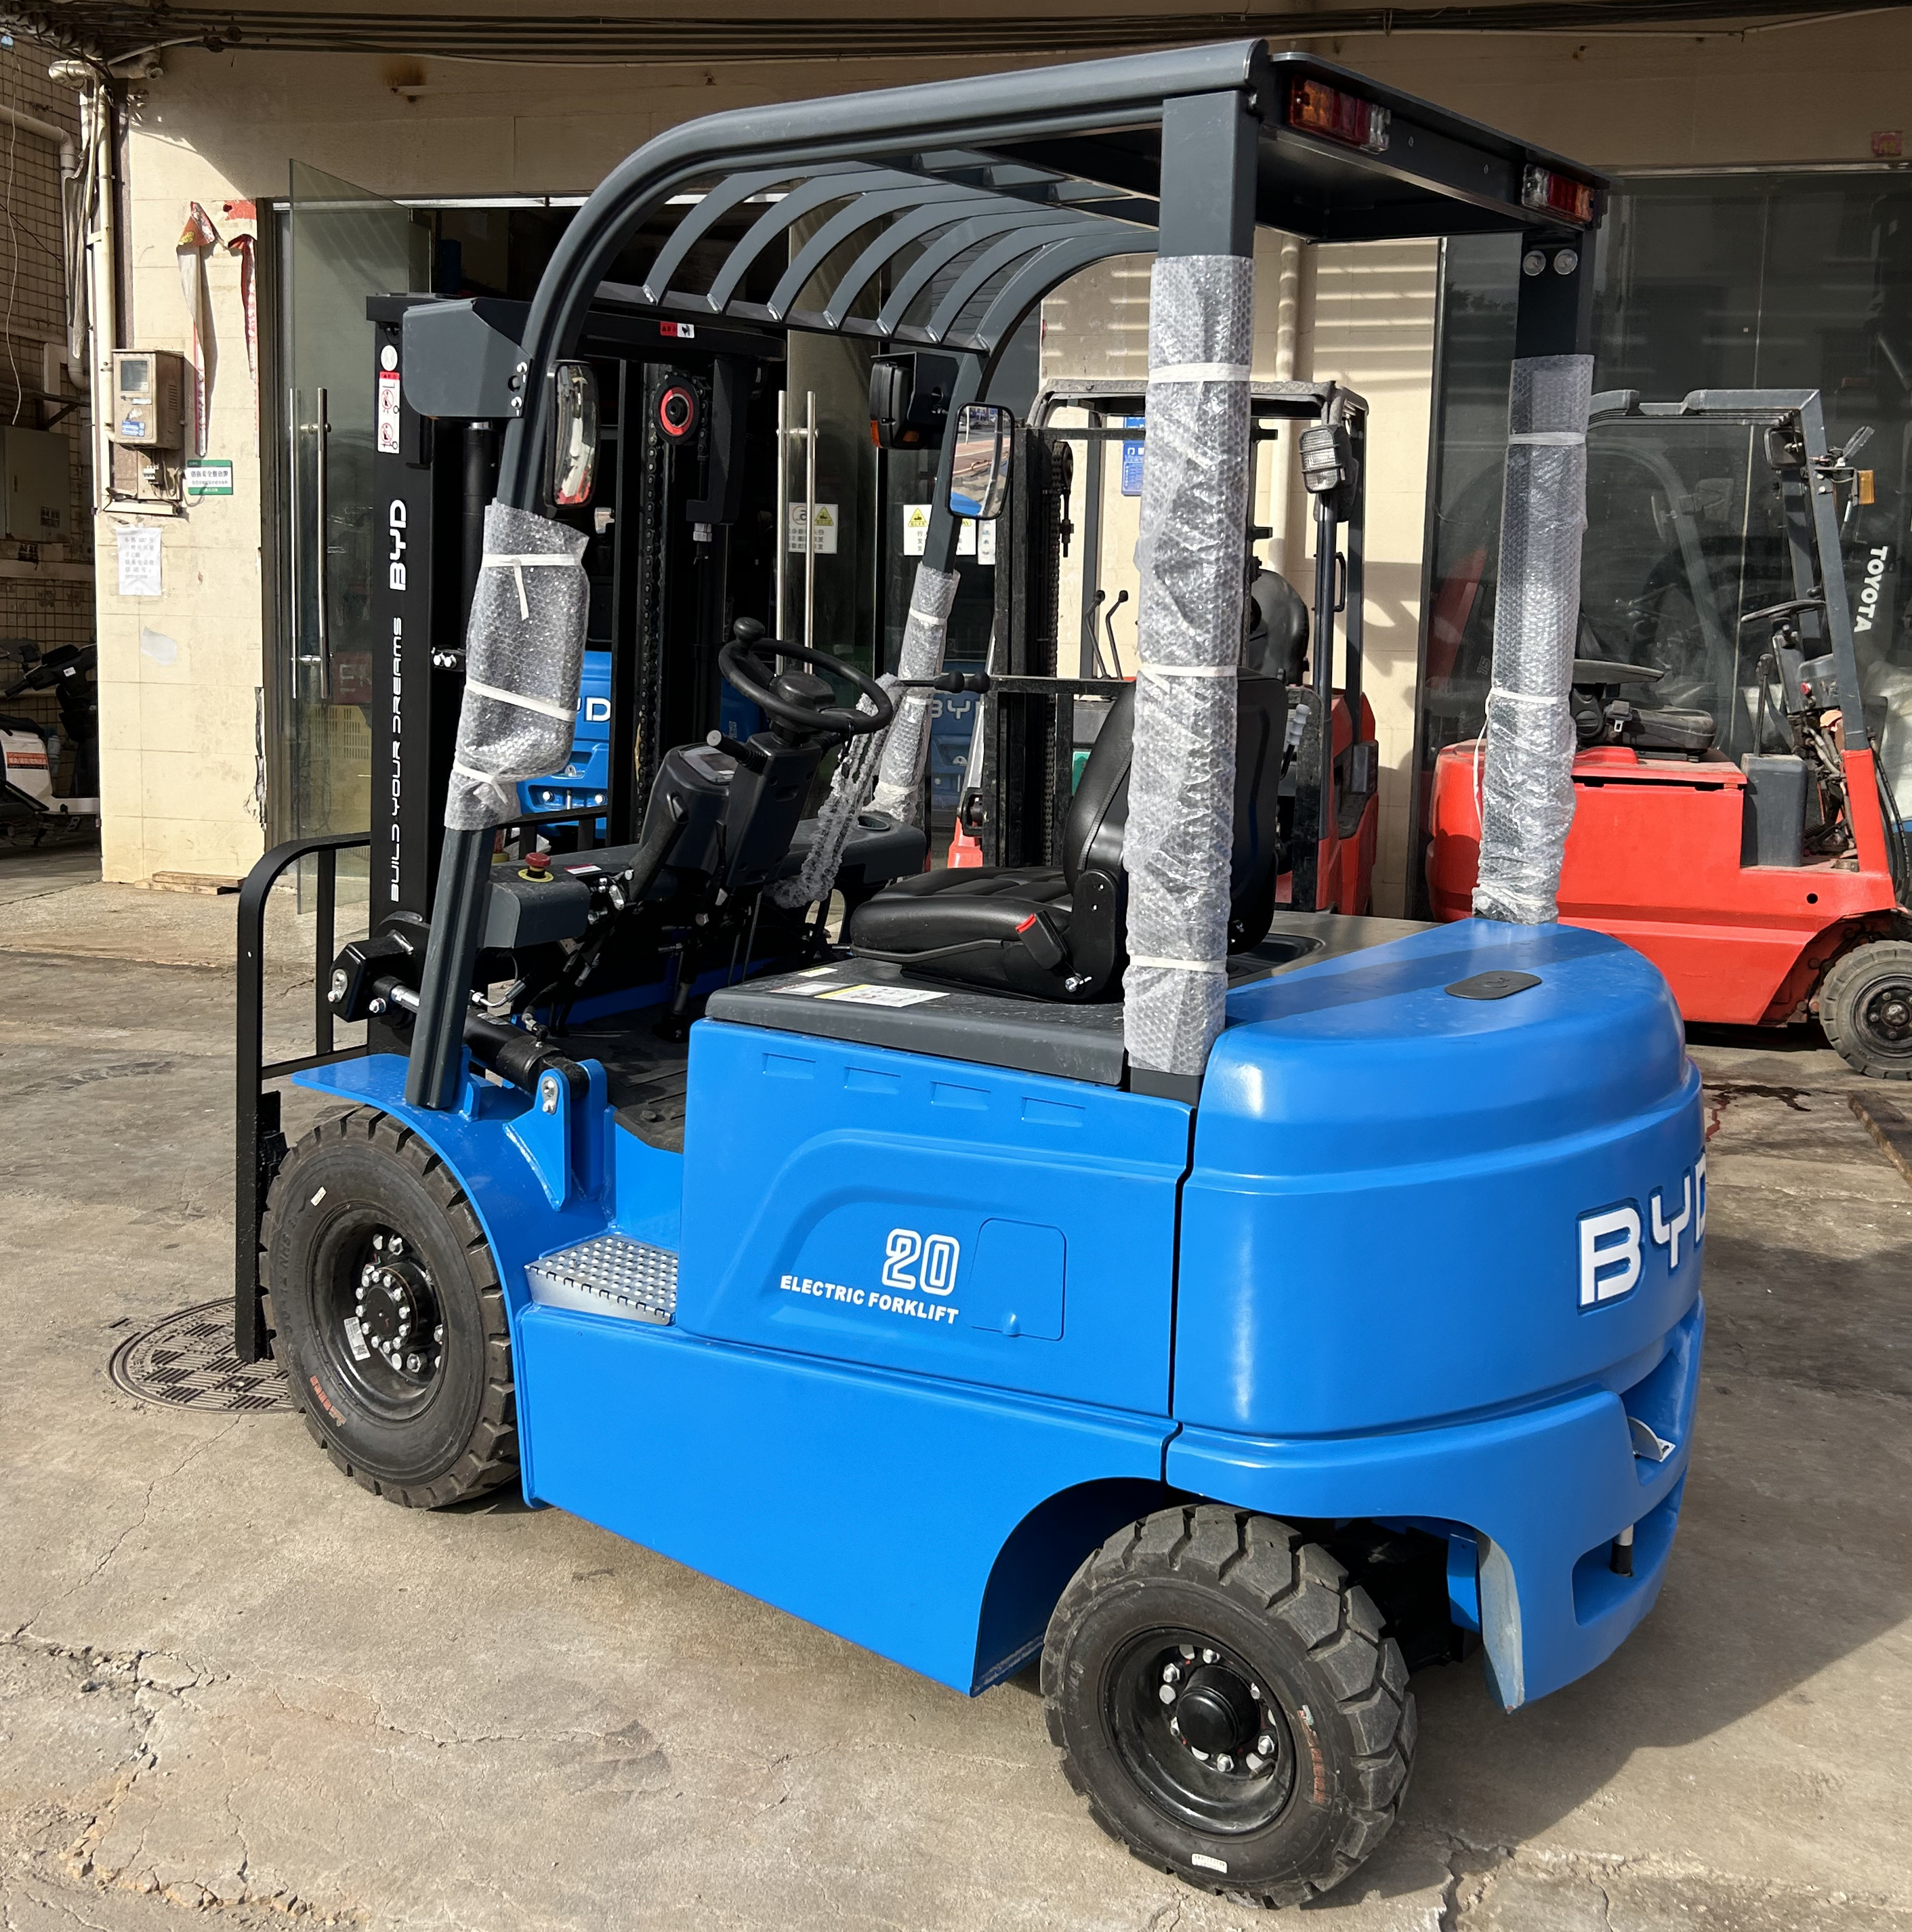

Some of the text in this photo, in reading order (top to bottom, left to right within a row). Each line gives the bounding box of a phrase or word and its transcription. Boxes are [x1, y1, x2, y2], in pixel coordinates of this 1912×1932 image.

[390, 499, 407, 591] BYD
[1854, 546, 1888, 632] TOYOTA
[931, 699, 980, 719] BY
[391, 617, 402, 902] BUILD YOUR DREAMS
[781, 1275, 959, 1324] ELECTRIC FORKLIFT
[881, 1228, 960, 1296] 20
